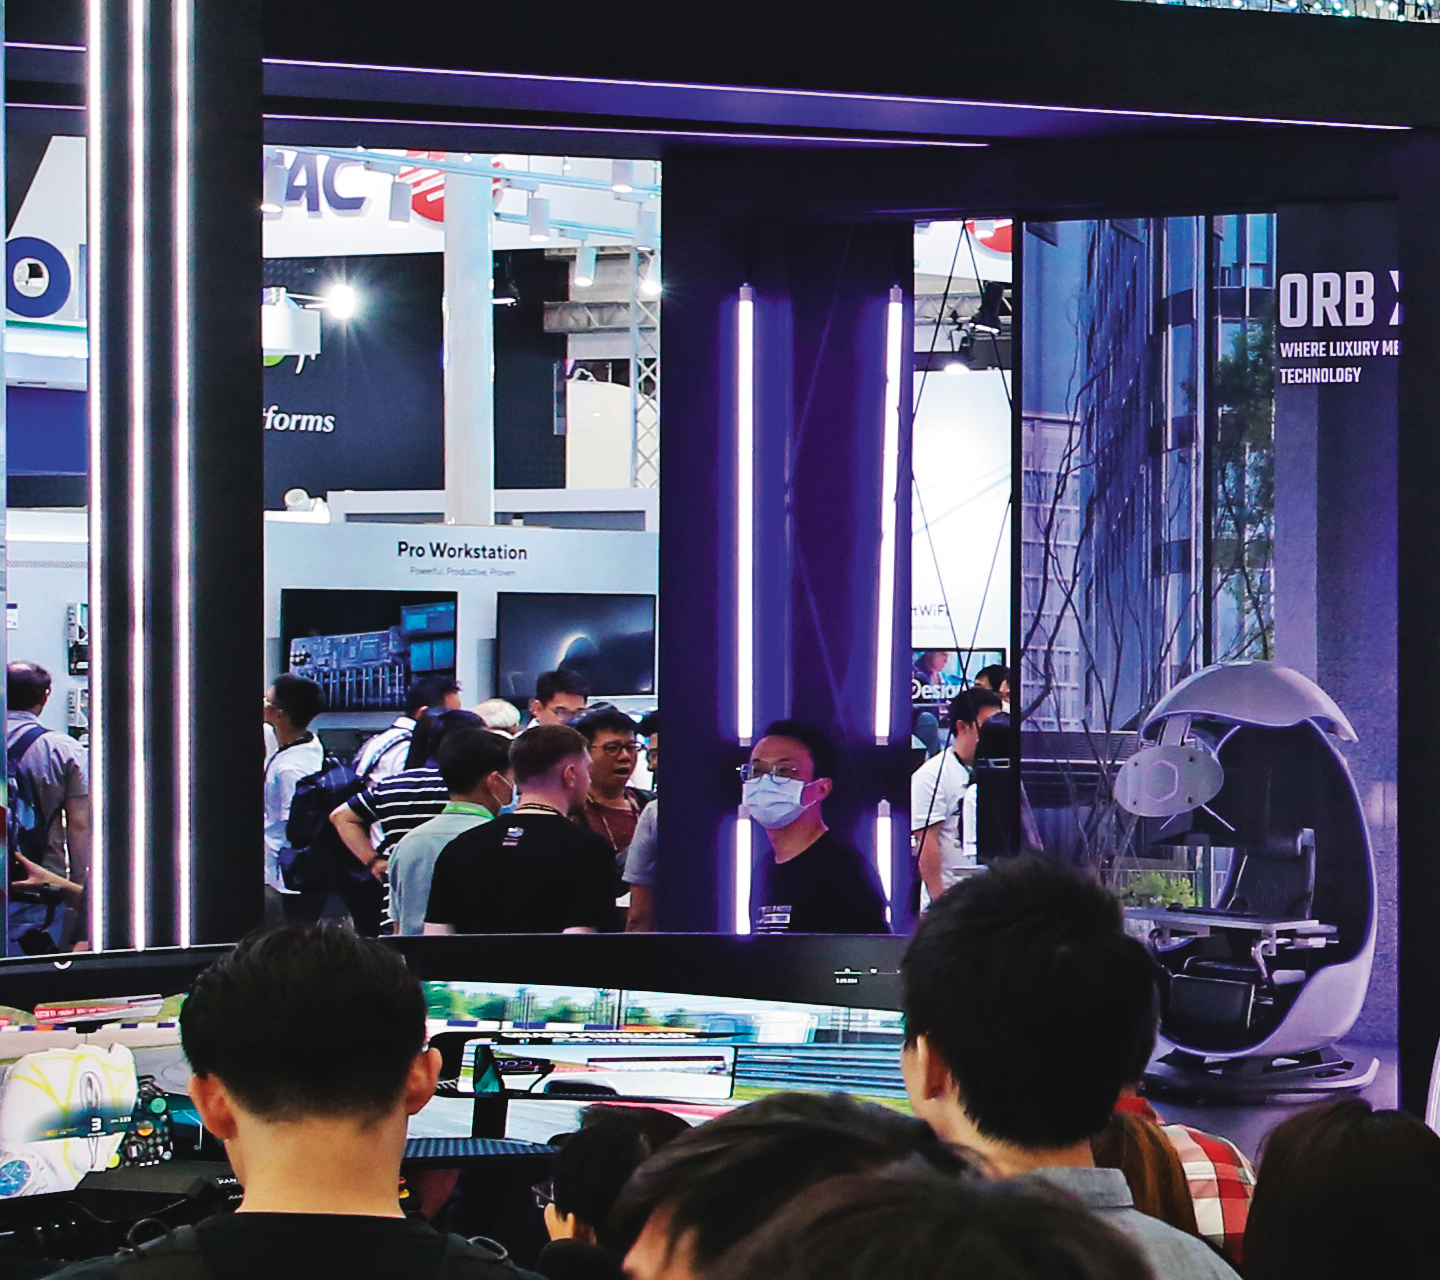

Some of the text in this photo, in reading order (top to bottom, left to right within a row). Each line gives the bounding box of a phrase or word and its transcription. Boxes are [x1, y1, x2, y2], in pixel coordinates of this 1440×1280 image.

[1280, 271, 1375, 328] ORB
[1280, 341, 1327, 357] WHERE
[1329, 340, 1380, 357] LUXURY
[1280, 367, 1361, 384] TECHNOLOGY
[397, 541, 528, 560] Pro Workstation
